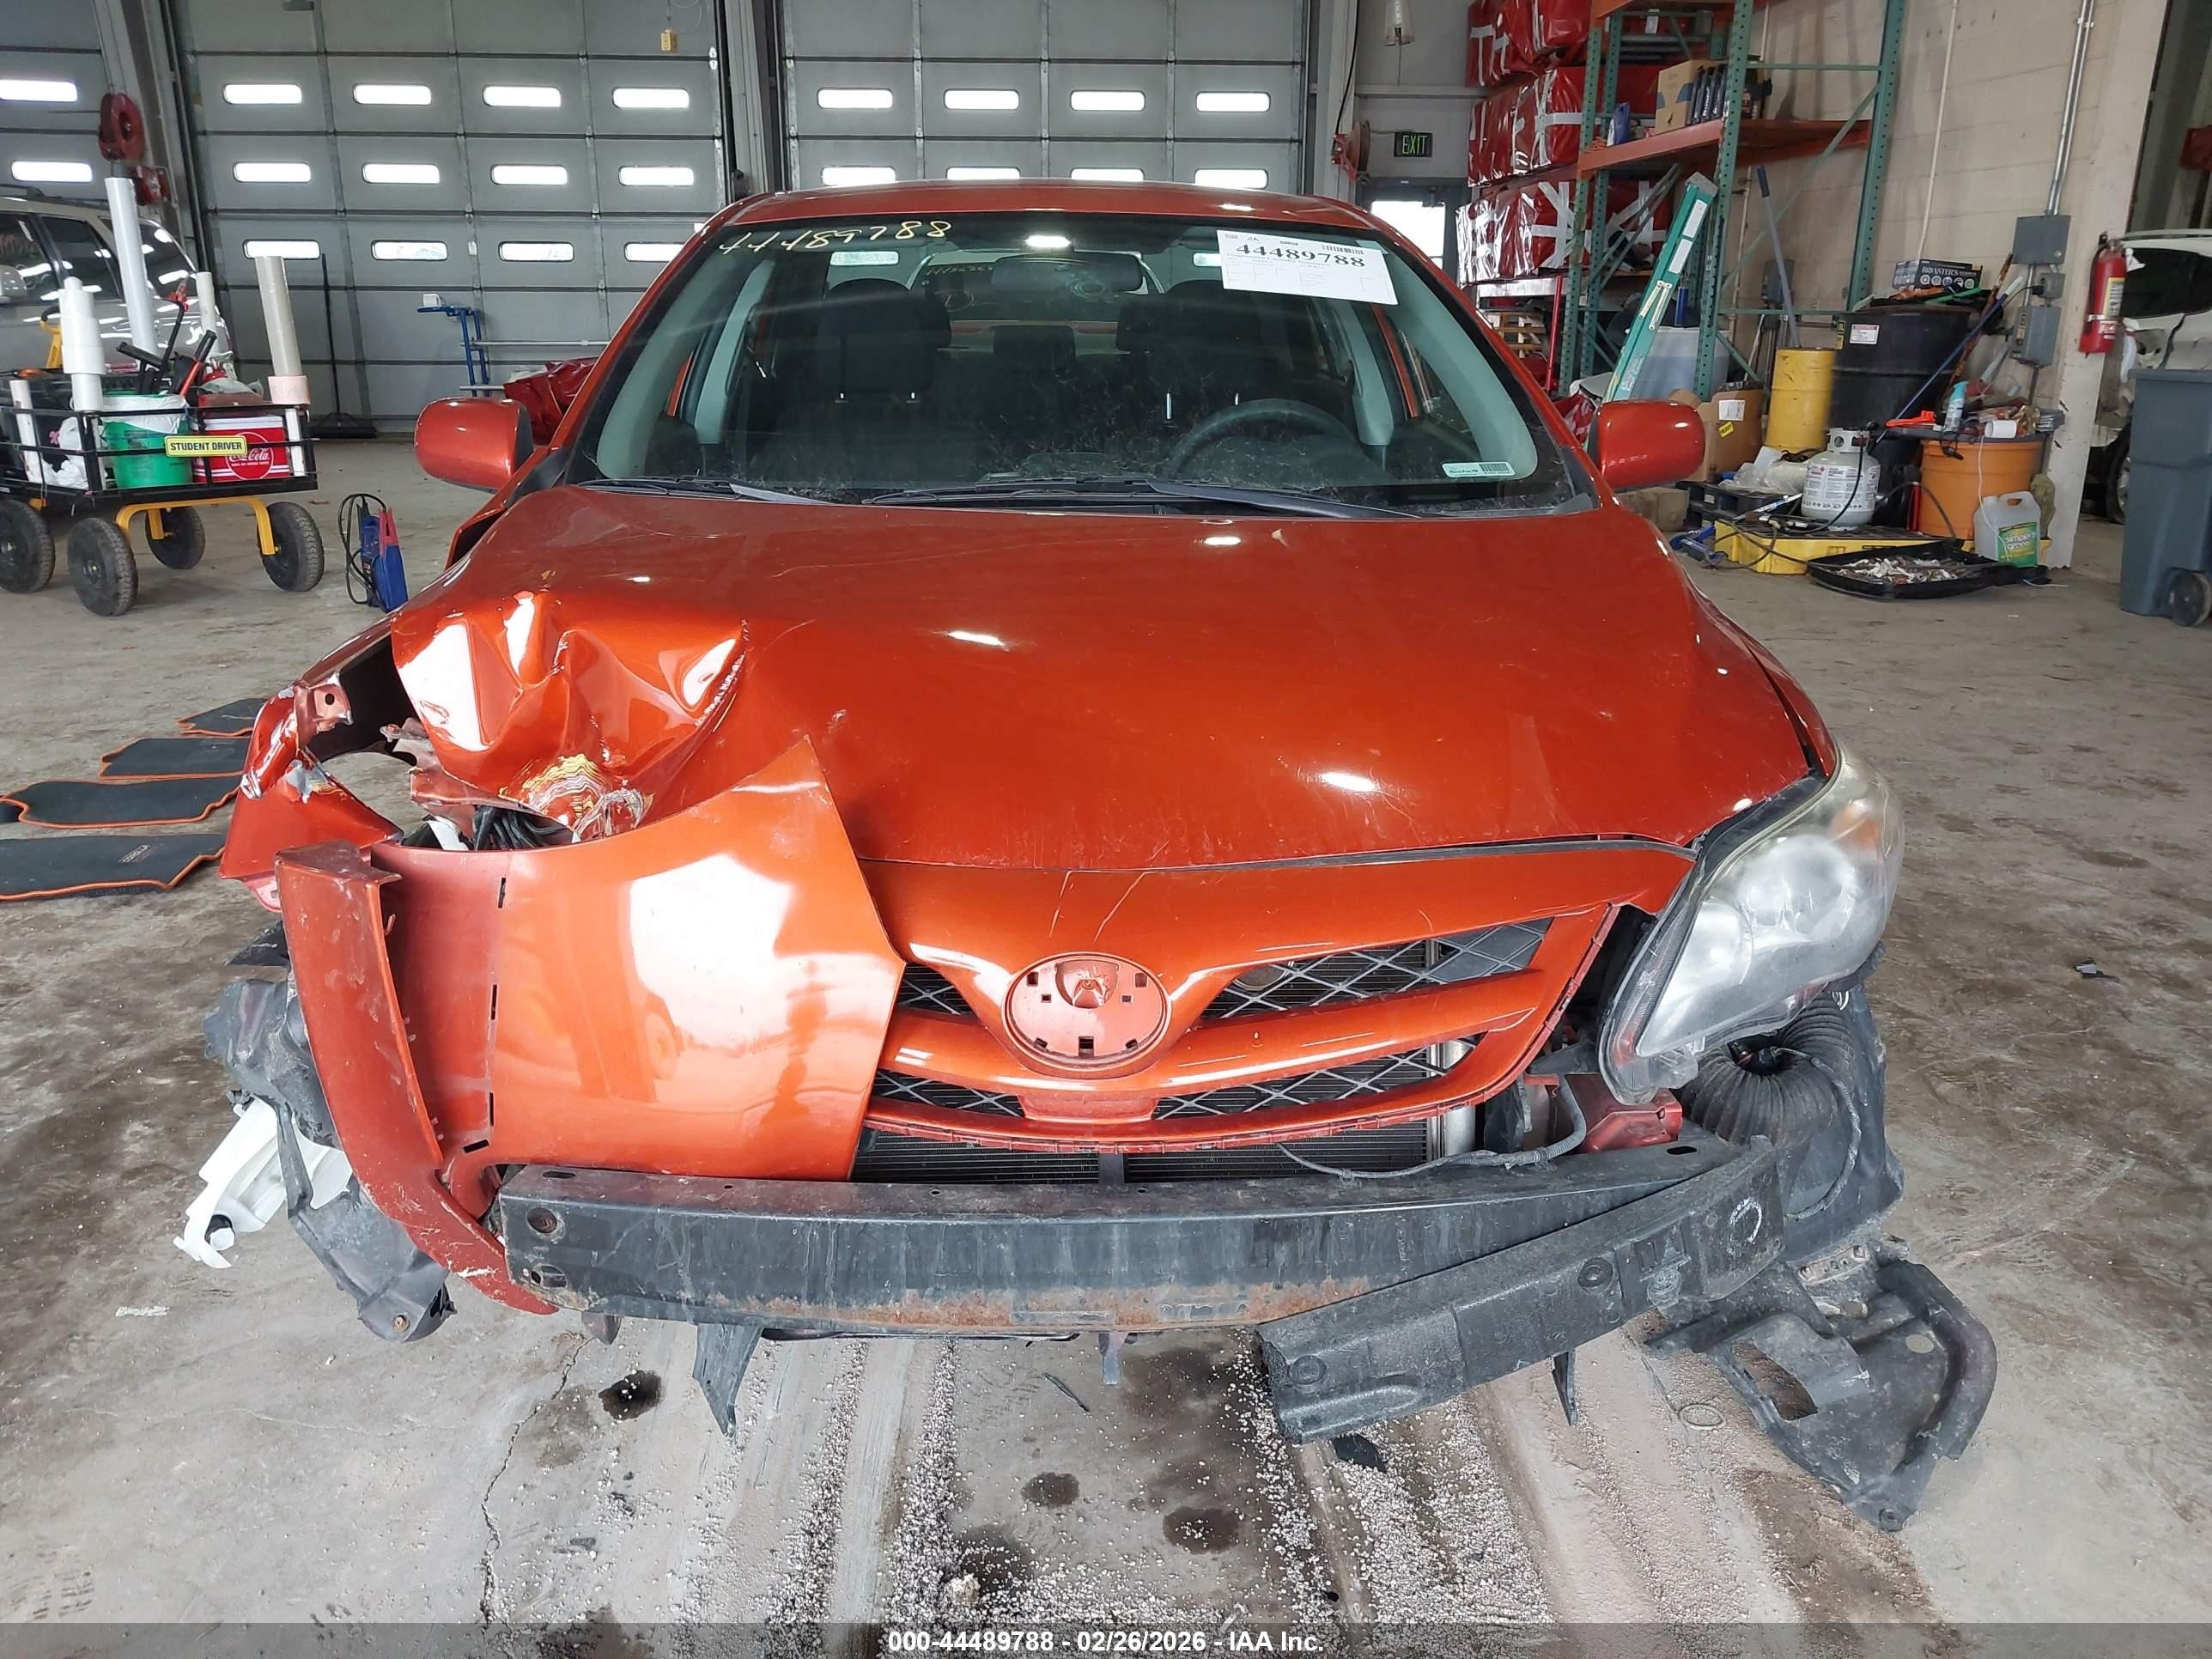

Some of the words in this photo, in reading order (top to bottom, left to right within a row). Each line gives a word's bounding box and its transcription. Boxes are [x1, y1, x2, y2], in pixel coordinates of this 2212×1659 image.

[1401, 135, 1428, 155] EXIT
[1236, 244, 1366, 268] 44489788
[170, 442, 210, 451] STUDENT
[212, 441, 242, 450] DRIVER
